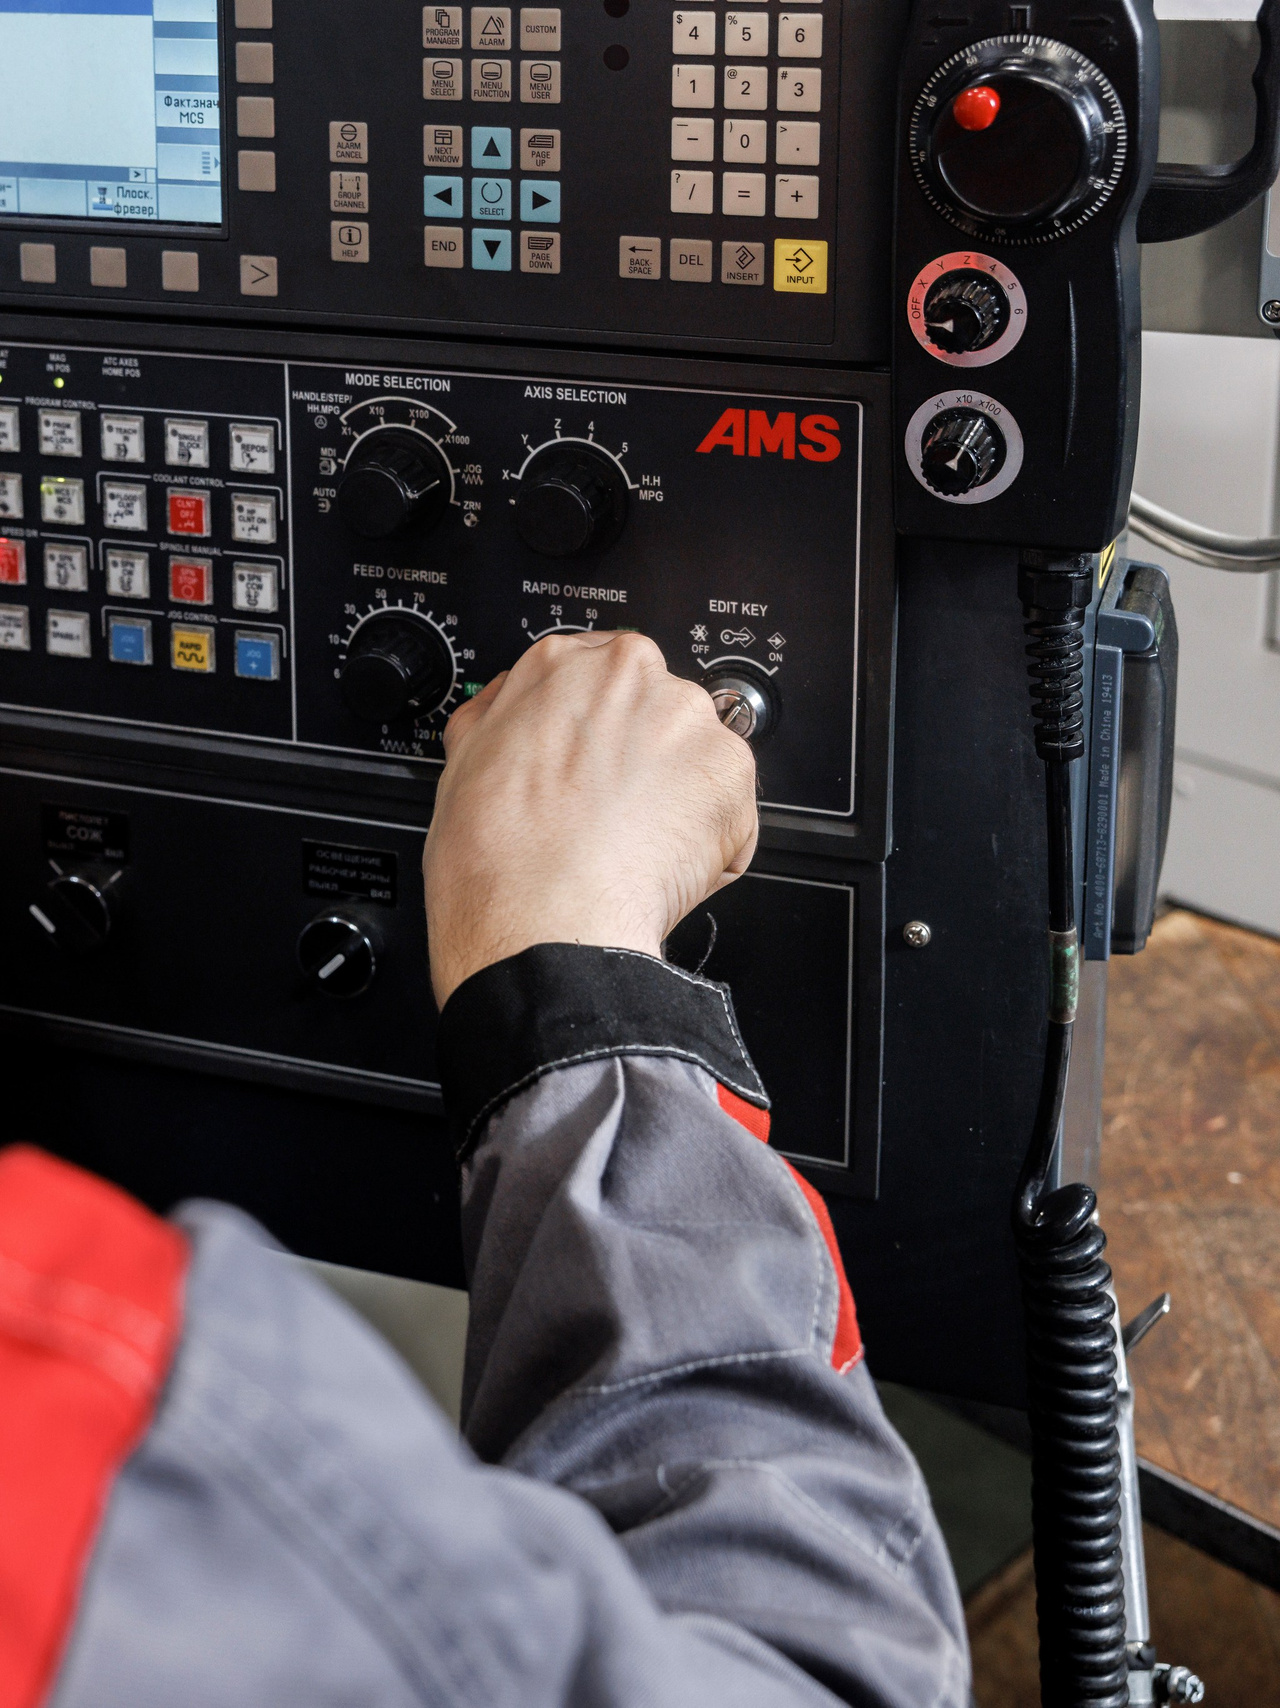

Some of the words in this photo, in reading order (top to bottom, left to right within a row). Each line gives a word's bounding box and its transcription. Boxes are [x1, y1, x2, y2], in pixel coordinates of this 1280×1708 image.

[426, 29, 460, 37] PROGRAM
[688, 26, 699, 40] 4
[742, 27, 751, 41] 5
[795, 28, 805, 42] 6
[426, 37, 460, 45] MANAGER
[479, 38, 505, 46] ALARM
[432, 80, 454, 88] MENU
[480, 81, 502, 89] MENU
[530, 83, 552, 91] MENU
[689, 79, 696, 93] 1
[741, 81, 751, 95] 2
[794, 82, 804, 96] 3
[431, 88, 455, 96] SELECT
[474, 89, 509, 98] FUNCTION
[531, 91, 551, 99] USER
[179, 113, 204, 124] MCS
[740, 134, 749, 148] 0
[336, 151, 362, 159] CANCEL
[428, 154, 460, 163] WINDOW
[531, 151, 550, 159] PAGE
[338, 191, 361, 199] GROUP
[334, 200, 366, 209] CHANNEL
[431, 241, 456, 251] END
[531, 253, 550, 261] PAGE
[629, 258, 652, 266] BACK-
[679, 254, 703, 265] DEL
[964, 256, 970, 264] Z
[529, 261, 552, 269] DOWN
[936, 261, 944, 270] Y
[989, 264, 997, 272] 4
[629, 266, 652, 275] SPACE
[726, 272, 759, 281] INSERT
[787, 276, 815, 284] INPUT
[918, 279, 928, 288] X
[912, 297, 921, 319] OFF
[49, 353, 66, 363] MAG
[103, 357, 118, 366] ATC
[119, 358, 139, 367] AXES
[46, 364, 54, 372] IN
[102, 367, 124, 376] HOME
[125, 369, 141, 378] POS
[345, 373, 380, 387] MODE
[383, 376, 450, 392] SELECTION
[292, 391, 352, 403] HANDLE/STEP/
[524, 386, 553, 399] AXIS
[556, 388, 626, 404] SELECTION
[956, 395, 973, 403] x10
[25, 396, 61, 407] PROGRAM
[61, 400, 97, 410] CONTROL
[934, 399, 945, 409] x1
[979, 400, 1001, 415] x100
[369, 406, 384, 415] X10
[409, 409, 429, 419] X100
[554, 419, 561, 429] Z
[588, 421, 594, 431] 4
[342, 427, 351, 435] X1
[695, 408, 841, 462] AMS
[445, 435, 470, 445] X1000
[521, 434, 529, 444] Y
[321, 448, 336, 457] MDI
[622, 442, 628, 453] 5
[463, 464, 482, 473] JOG
[502, 470, 509, 480] X
[153, 474, 188, 484] COOLANT
[189, 477, 225, 487] CONTROL
[642, 475, 660, 486] H.H
[313, 488, 336, 497] AUTO
[639, 490, 663, 501] MPG
[463, 501, 481, 510] ZRN
[353, 564, 384, 578] FEED
[387, 567, 447, 584] OVERRIDE
[375, 589, 387, 598] 50
[522, 581, 560, 596] RAPID
[563, 585, 627, 603] OVERRIDE
[413, 593, 425, 603] 70
[344, 604, 355, 614] 30
[550, 605, 562, 616] 25
[709, 600, 738, 614] EDIT
[741, 602, 768, 617] KEY
[167, 611, 182, 620] JOG
[184, 612, 218, 623] CONTROL
[586, 608, 598, 620] 50
[446, 615, 458, 625] 80
[521, 618, 528, 629] 0
[329, 635, 339, 644] 10
[691, 644, 709, 654] OFF
[463, 650, 475, 659] 90
[769, 653, 783, 662] ON
[1100, 708, 1112, 742] China
[1102, 747, 1110, 757] in
[1100, 761, 1110, 792] Made
